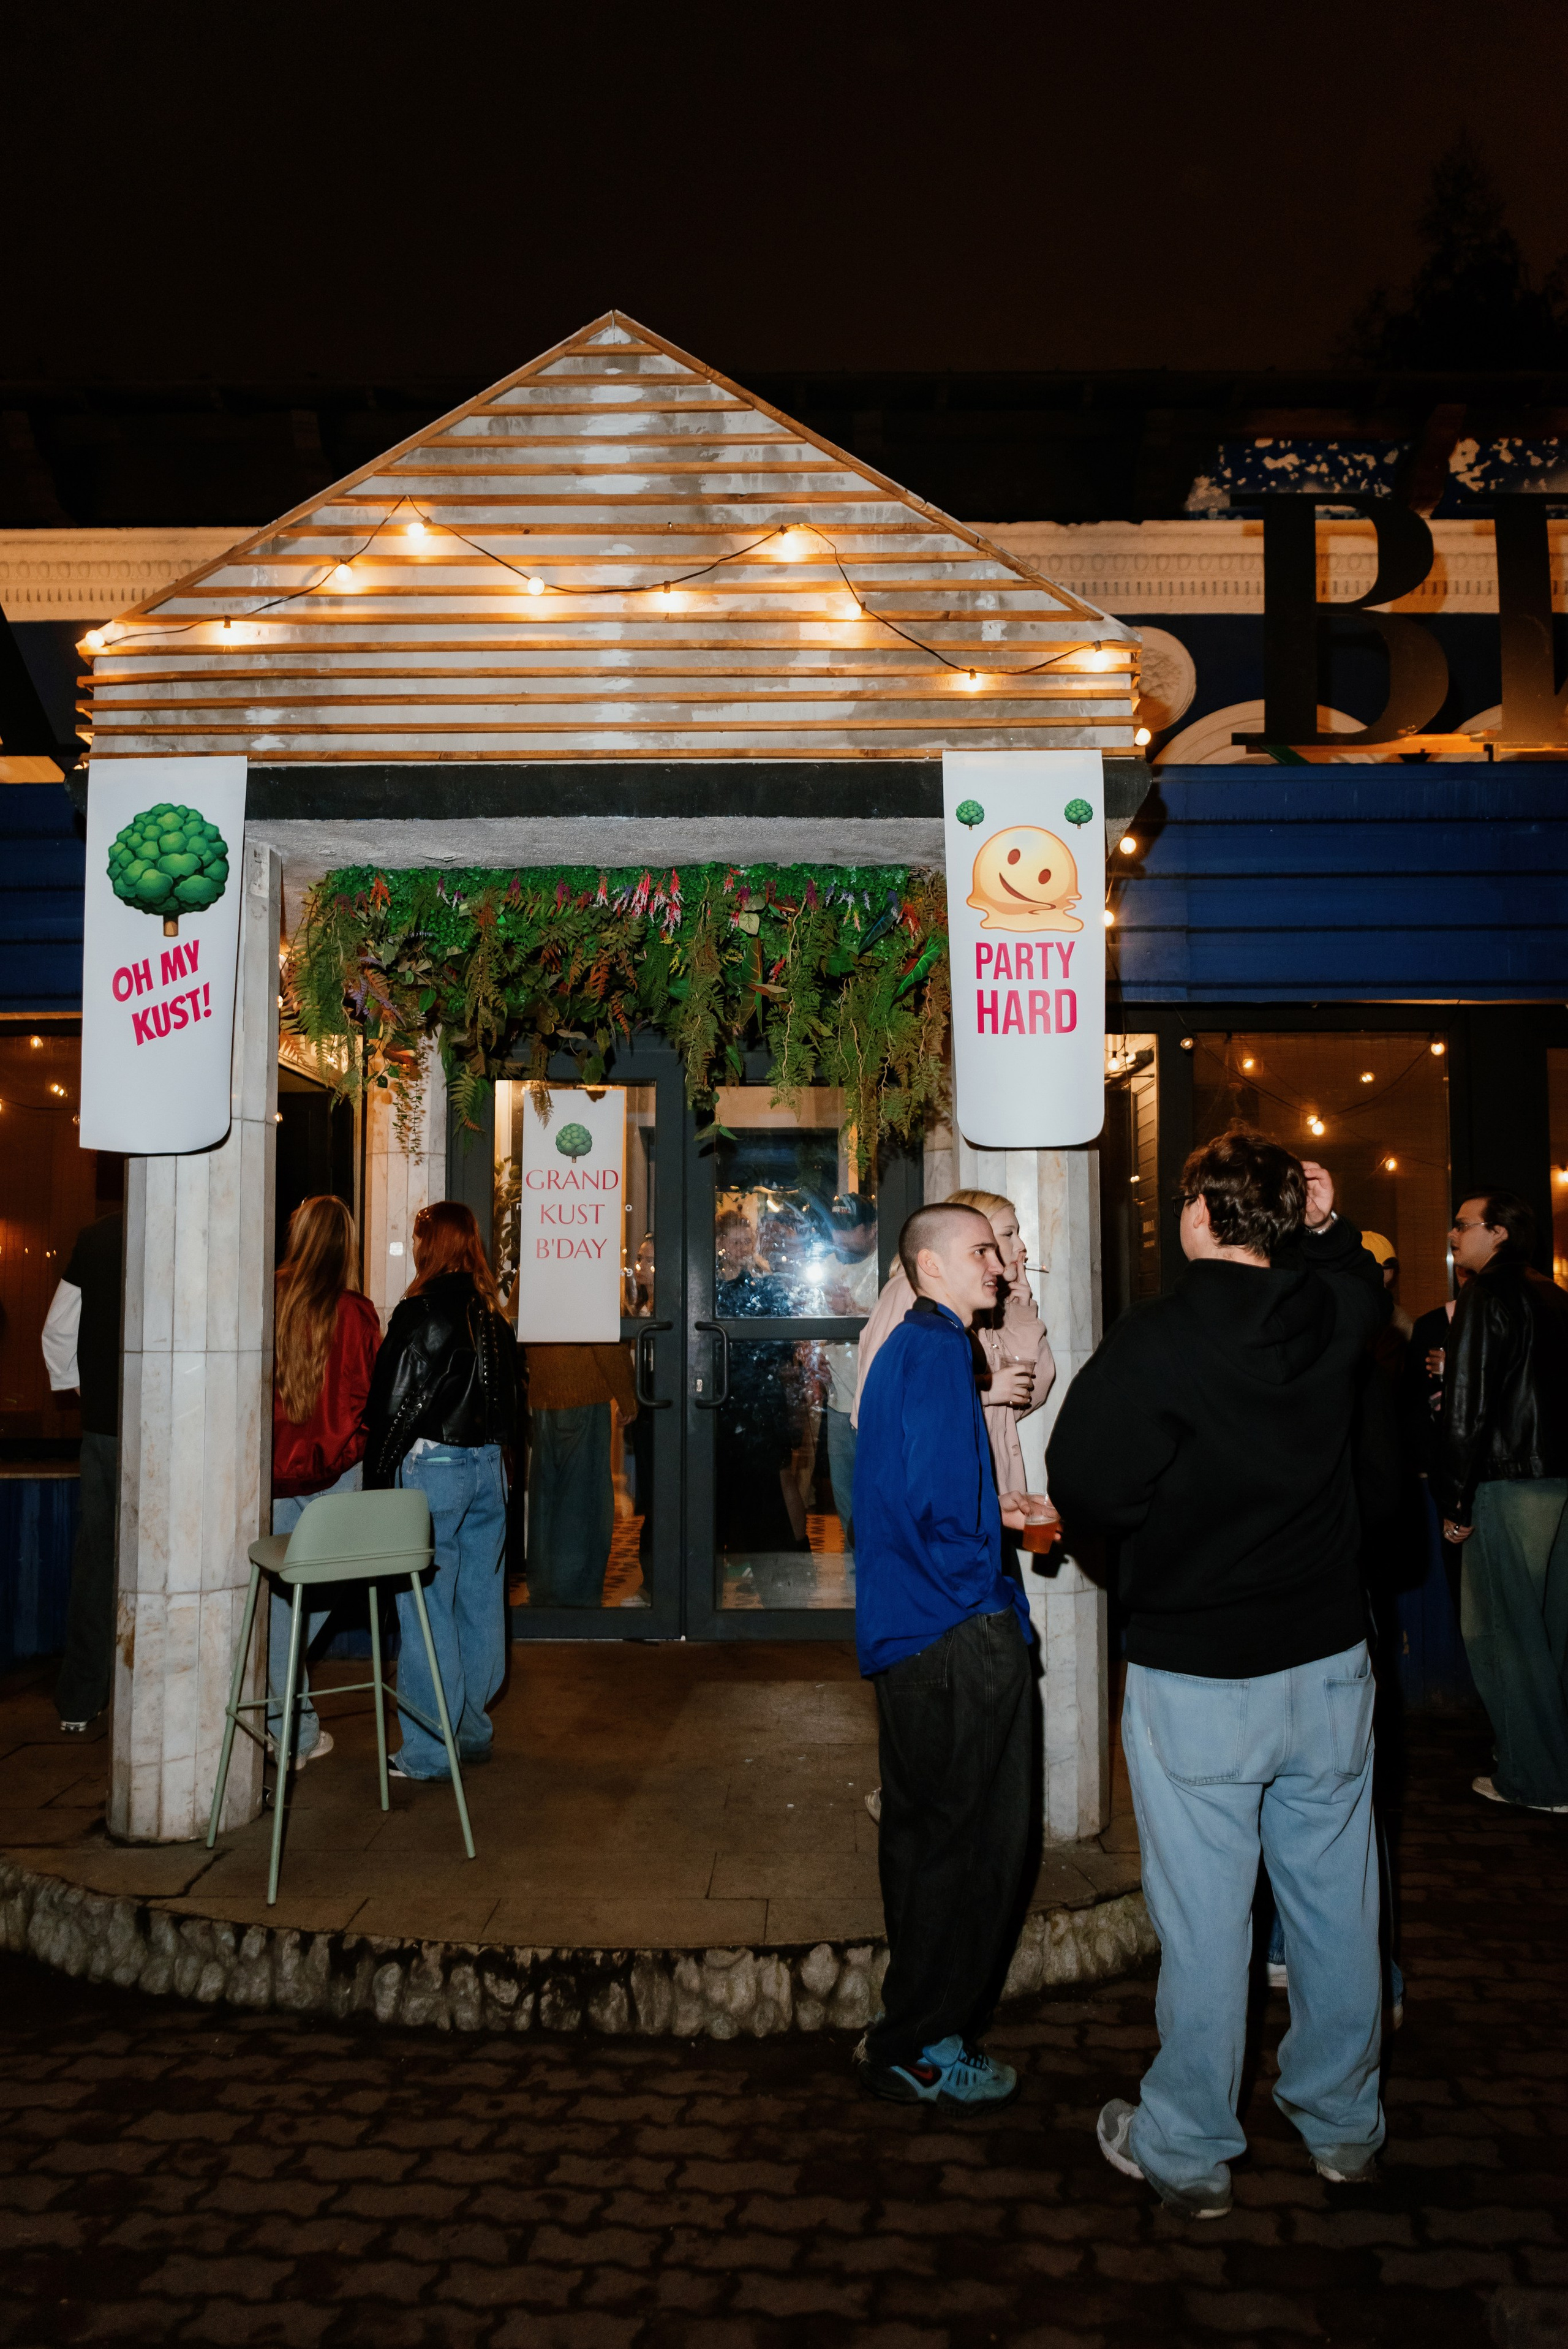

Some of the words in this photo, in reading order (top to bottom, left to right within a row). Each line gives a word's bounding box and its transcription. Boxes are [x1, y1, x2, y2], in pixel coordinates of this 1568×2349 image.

[111, 957, 154, 1003] OH
[160, 939, 200, 987] MY
[975, 940, 1076, 981] PARTY
[131, 981, 213, 1047] KUST!
[976, 988, 1078, 1035] HARD
[524, 1169, 619, 1191] GRAND
[540, 1203, 606, 1226] KUST
[536, 1237, 608, 1260] B'DAY
